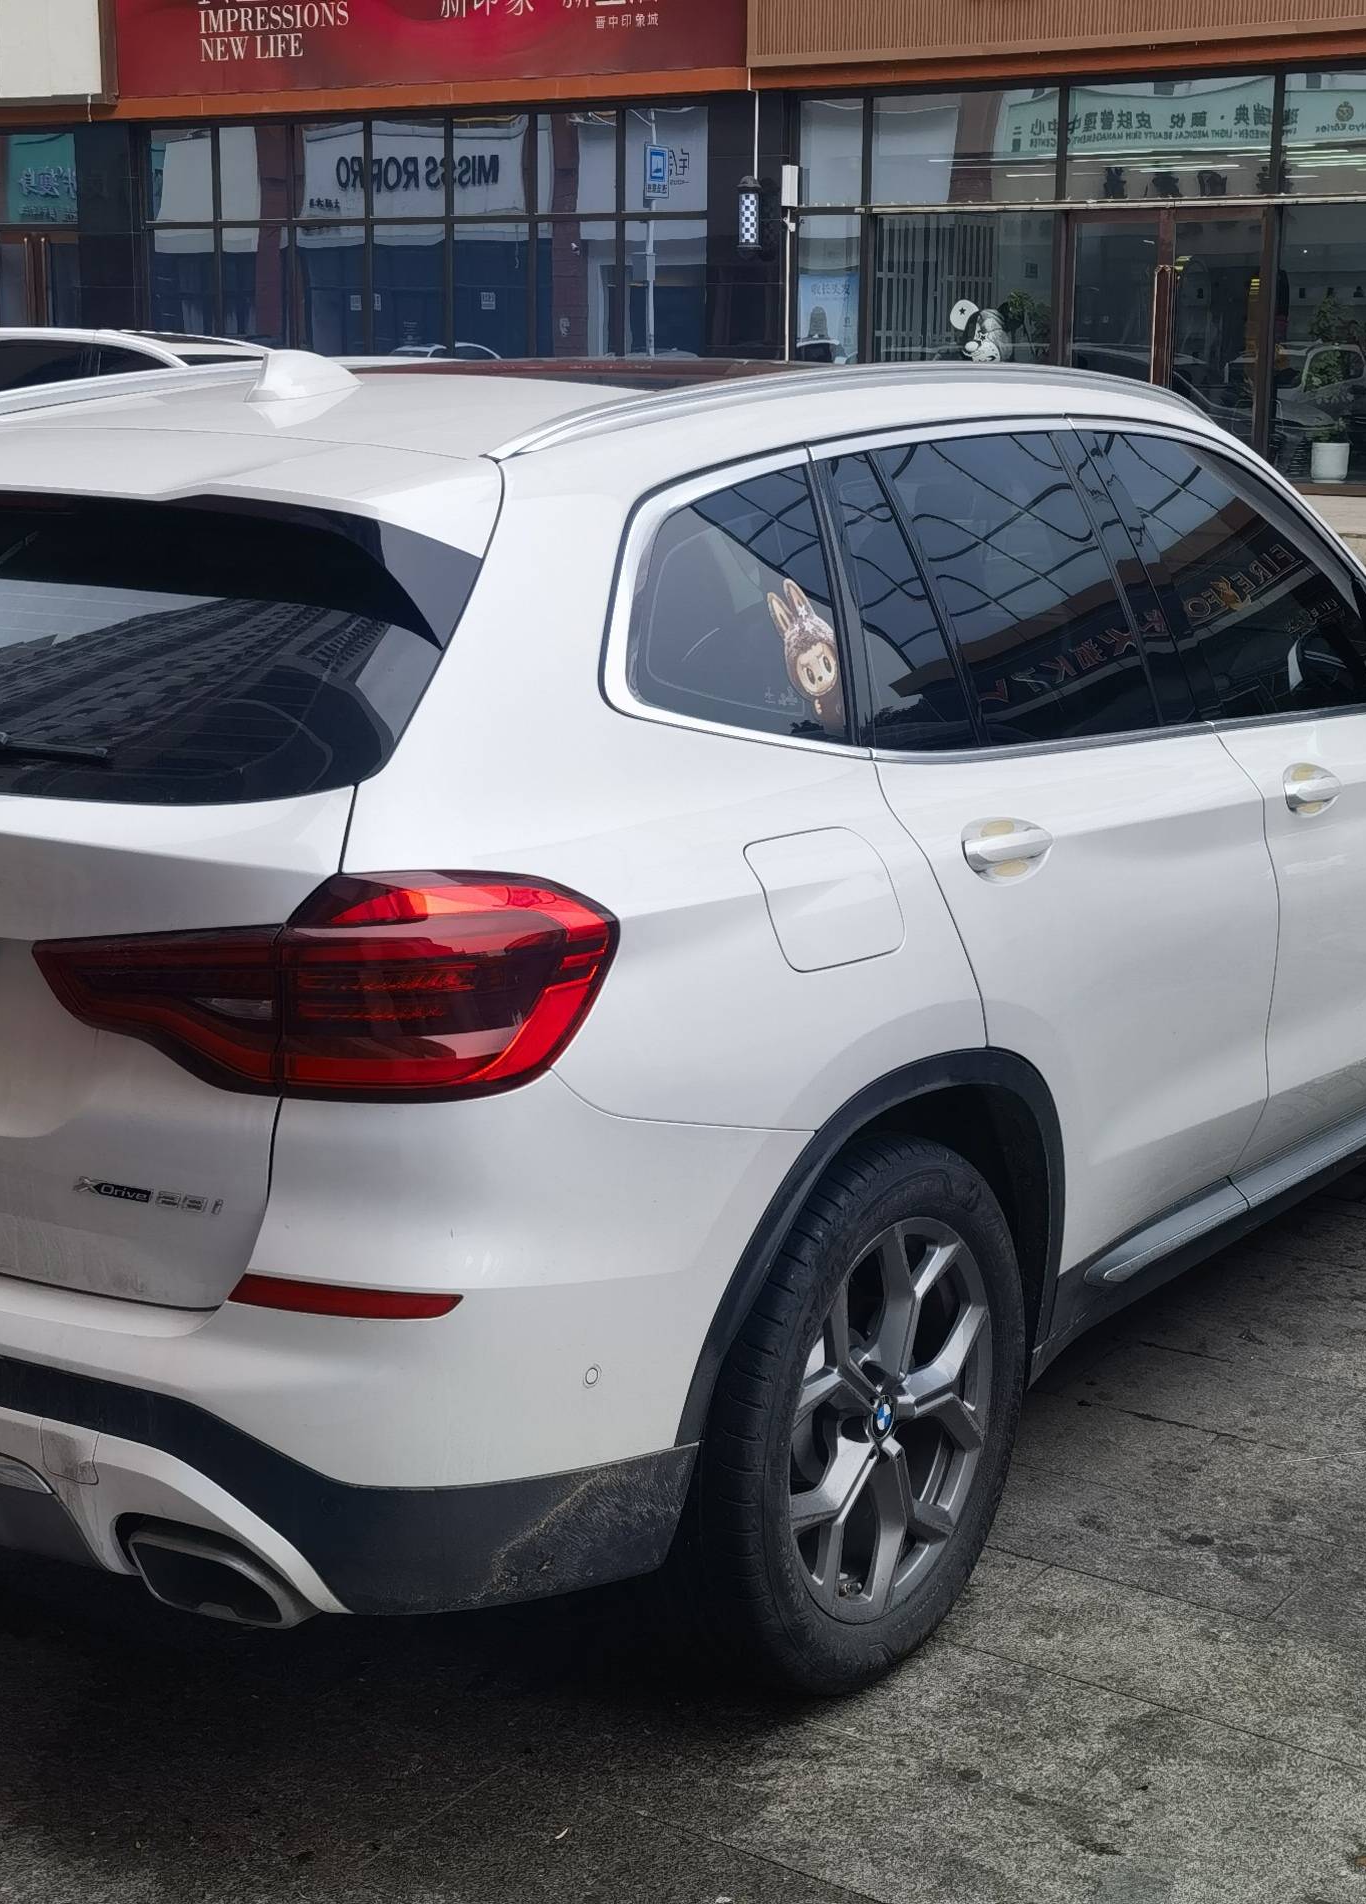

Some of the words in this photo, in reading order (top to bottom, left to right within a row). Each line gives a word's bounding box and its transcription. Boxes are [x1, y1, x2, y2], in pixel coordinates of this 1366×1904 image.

[198, 1, 349, 34] IMPRESSIONS
[594, 12, 660, 30] 晋中印象城
[200, 36, 248, 62] NEW
[255, 33, 304, 59] LIFE
